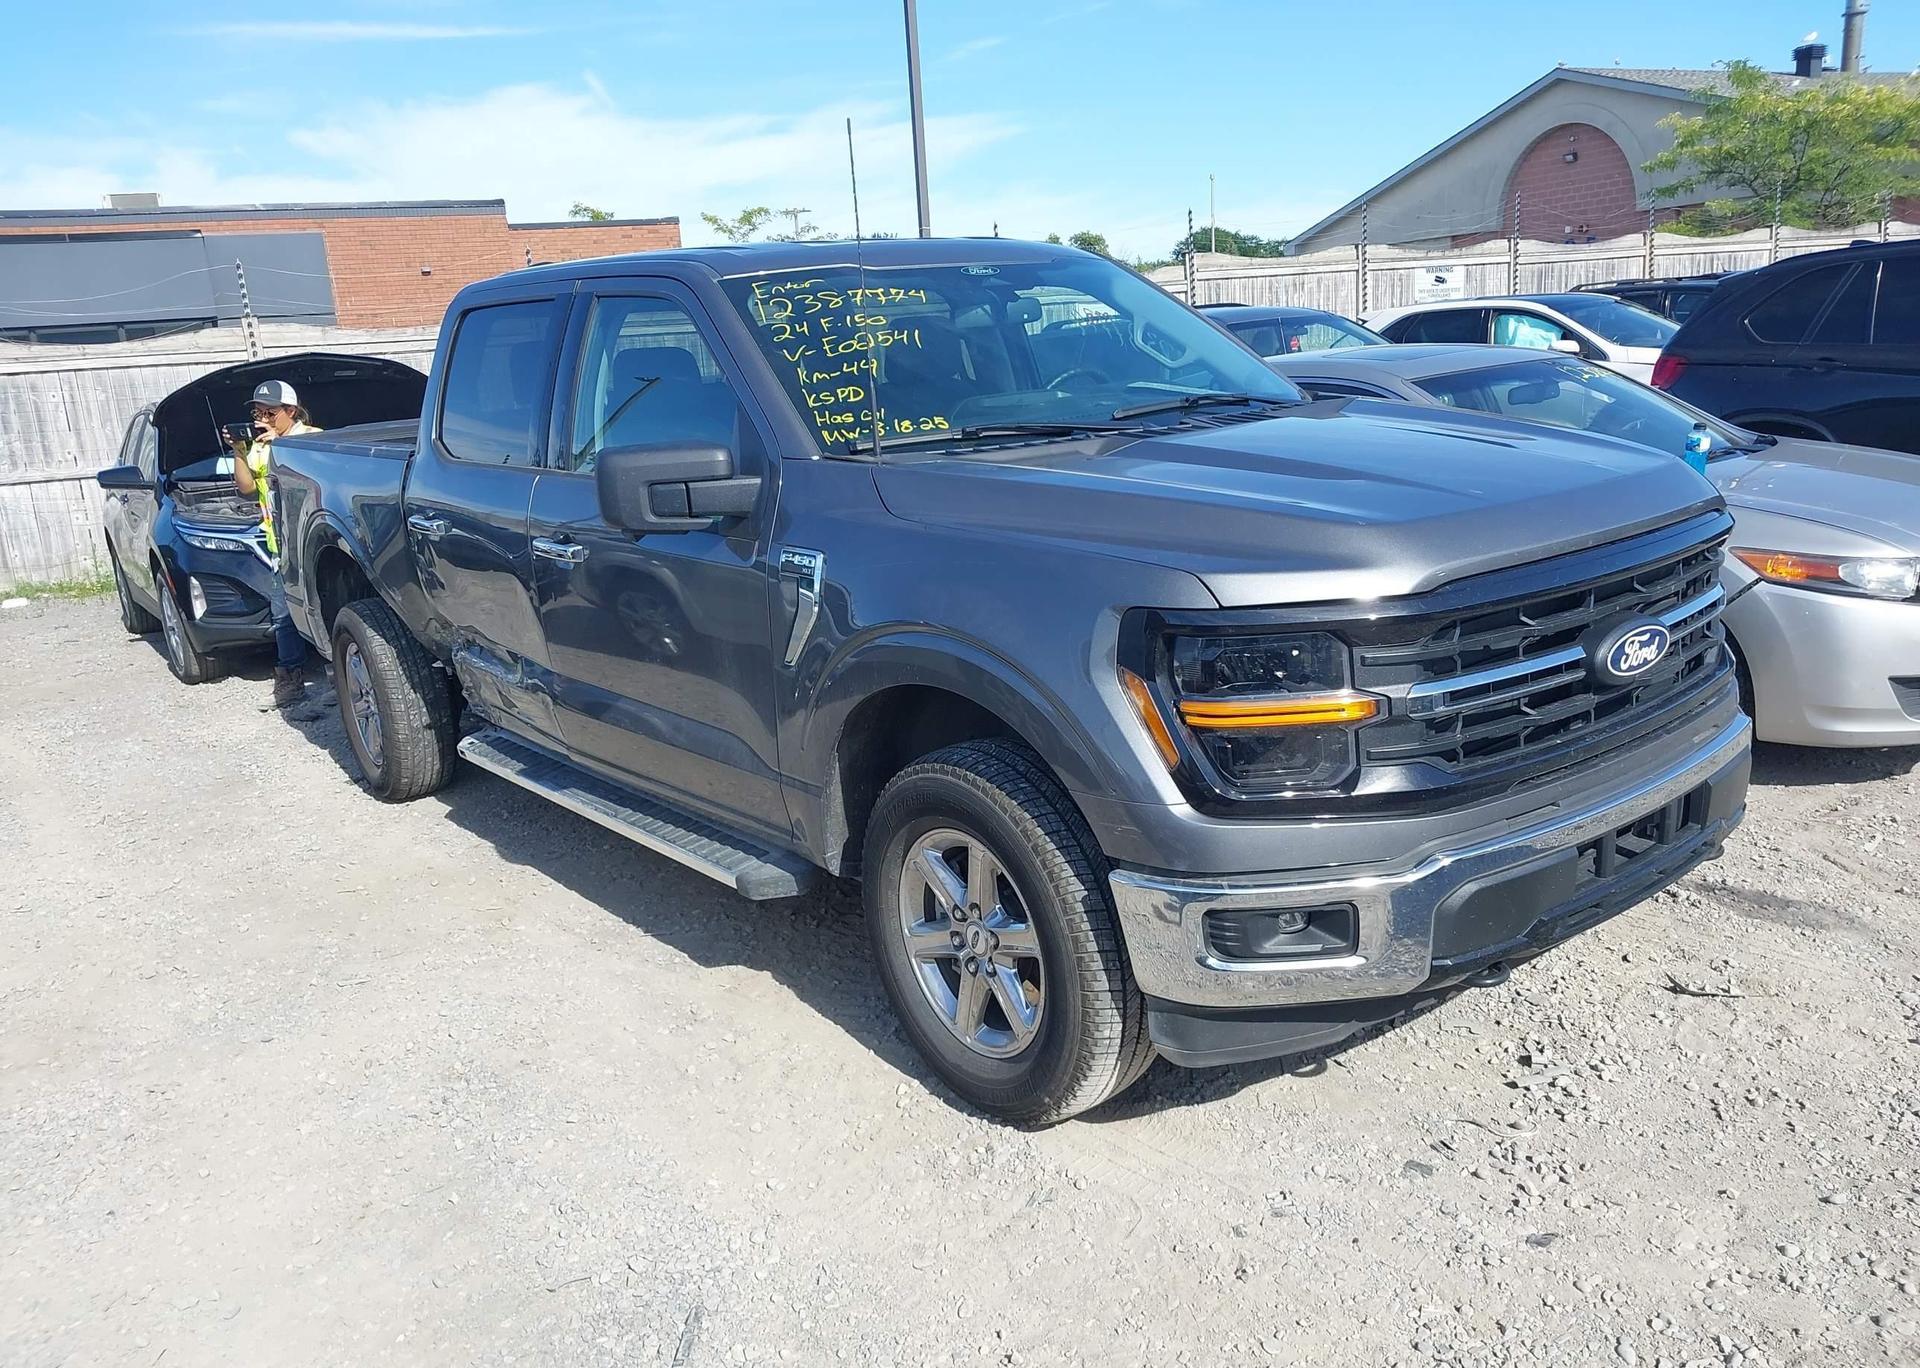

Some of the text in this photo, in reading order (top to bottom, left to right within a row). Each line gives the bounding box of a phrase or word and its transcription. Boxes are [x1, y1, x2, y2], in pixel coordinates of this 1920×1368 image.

[1425, 266, 1454, 274] WARNING
[770, 321, 810, 342] 24
[813, 410, 855, 427] Has
[1620, 632, 1660, 671] Ford
